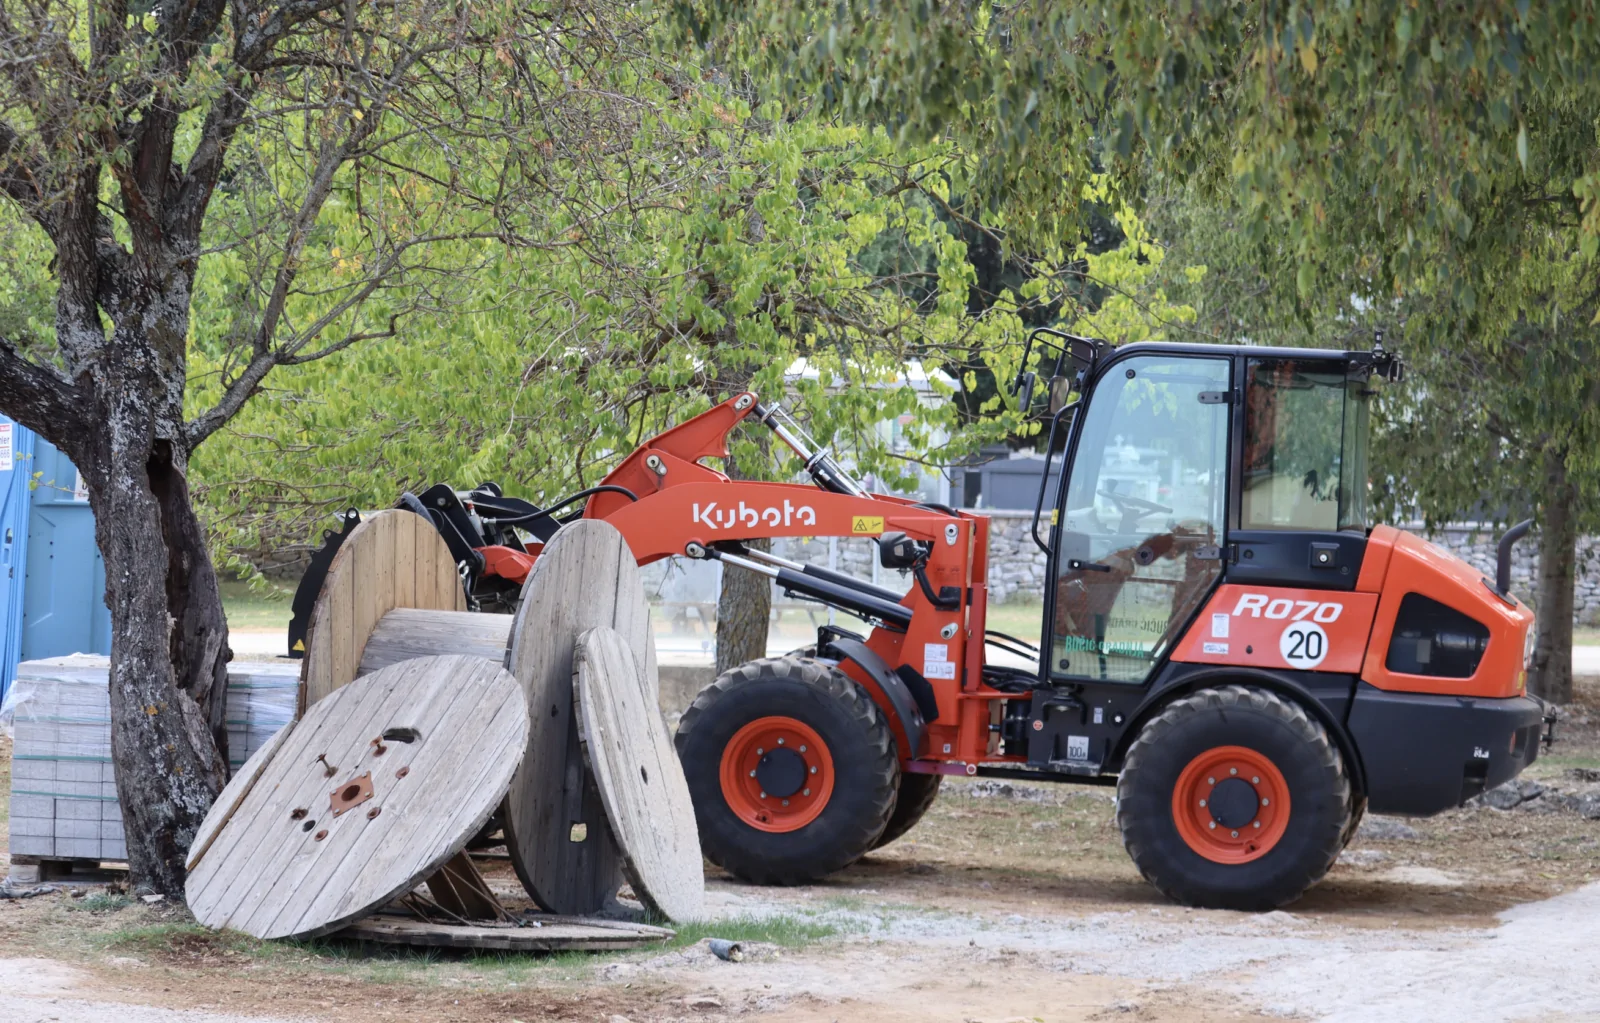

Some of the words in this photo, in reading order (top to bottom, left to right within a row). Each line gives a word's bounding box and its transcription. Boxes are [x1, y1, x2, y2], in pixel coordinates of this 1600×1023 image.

[693, 499, 816, 529] Kubota
[1287, 630, 1323, 660] 20
[1069, 746, 1083, 758] 100
